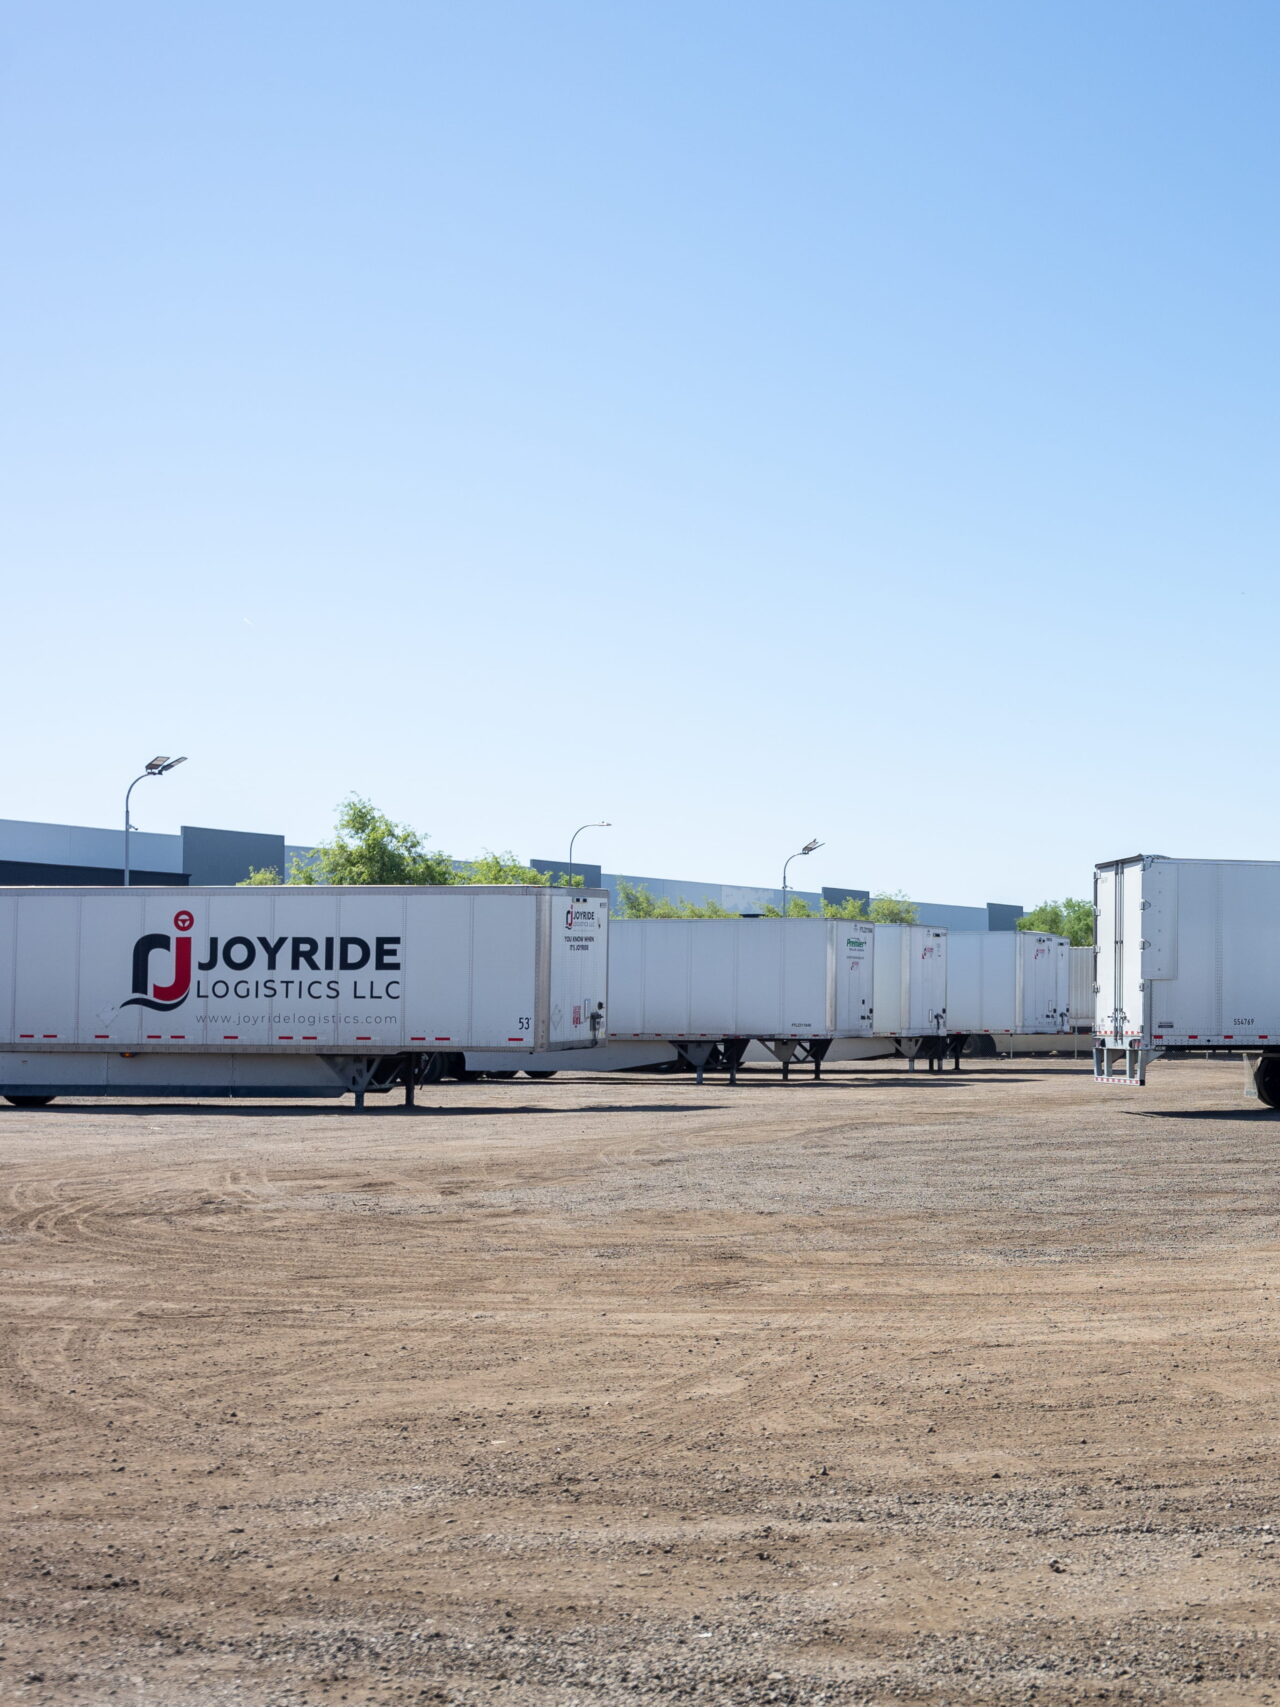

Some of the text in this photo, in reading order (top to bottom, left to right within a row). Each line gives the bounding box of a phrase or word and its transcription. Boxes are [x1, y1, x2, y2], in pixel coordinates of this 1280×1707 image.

[573, 911, 595, 921] JOYRIDE
[198, 936, 401, 971] JOYRIDE
[197, 980, 401, 999] LOGISTICS LLC
[196, 1012, 397, 1026] www.joyridelogistics.com
